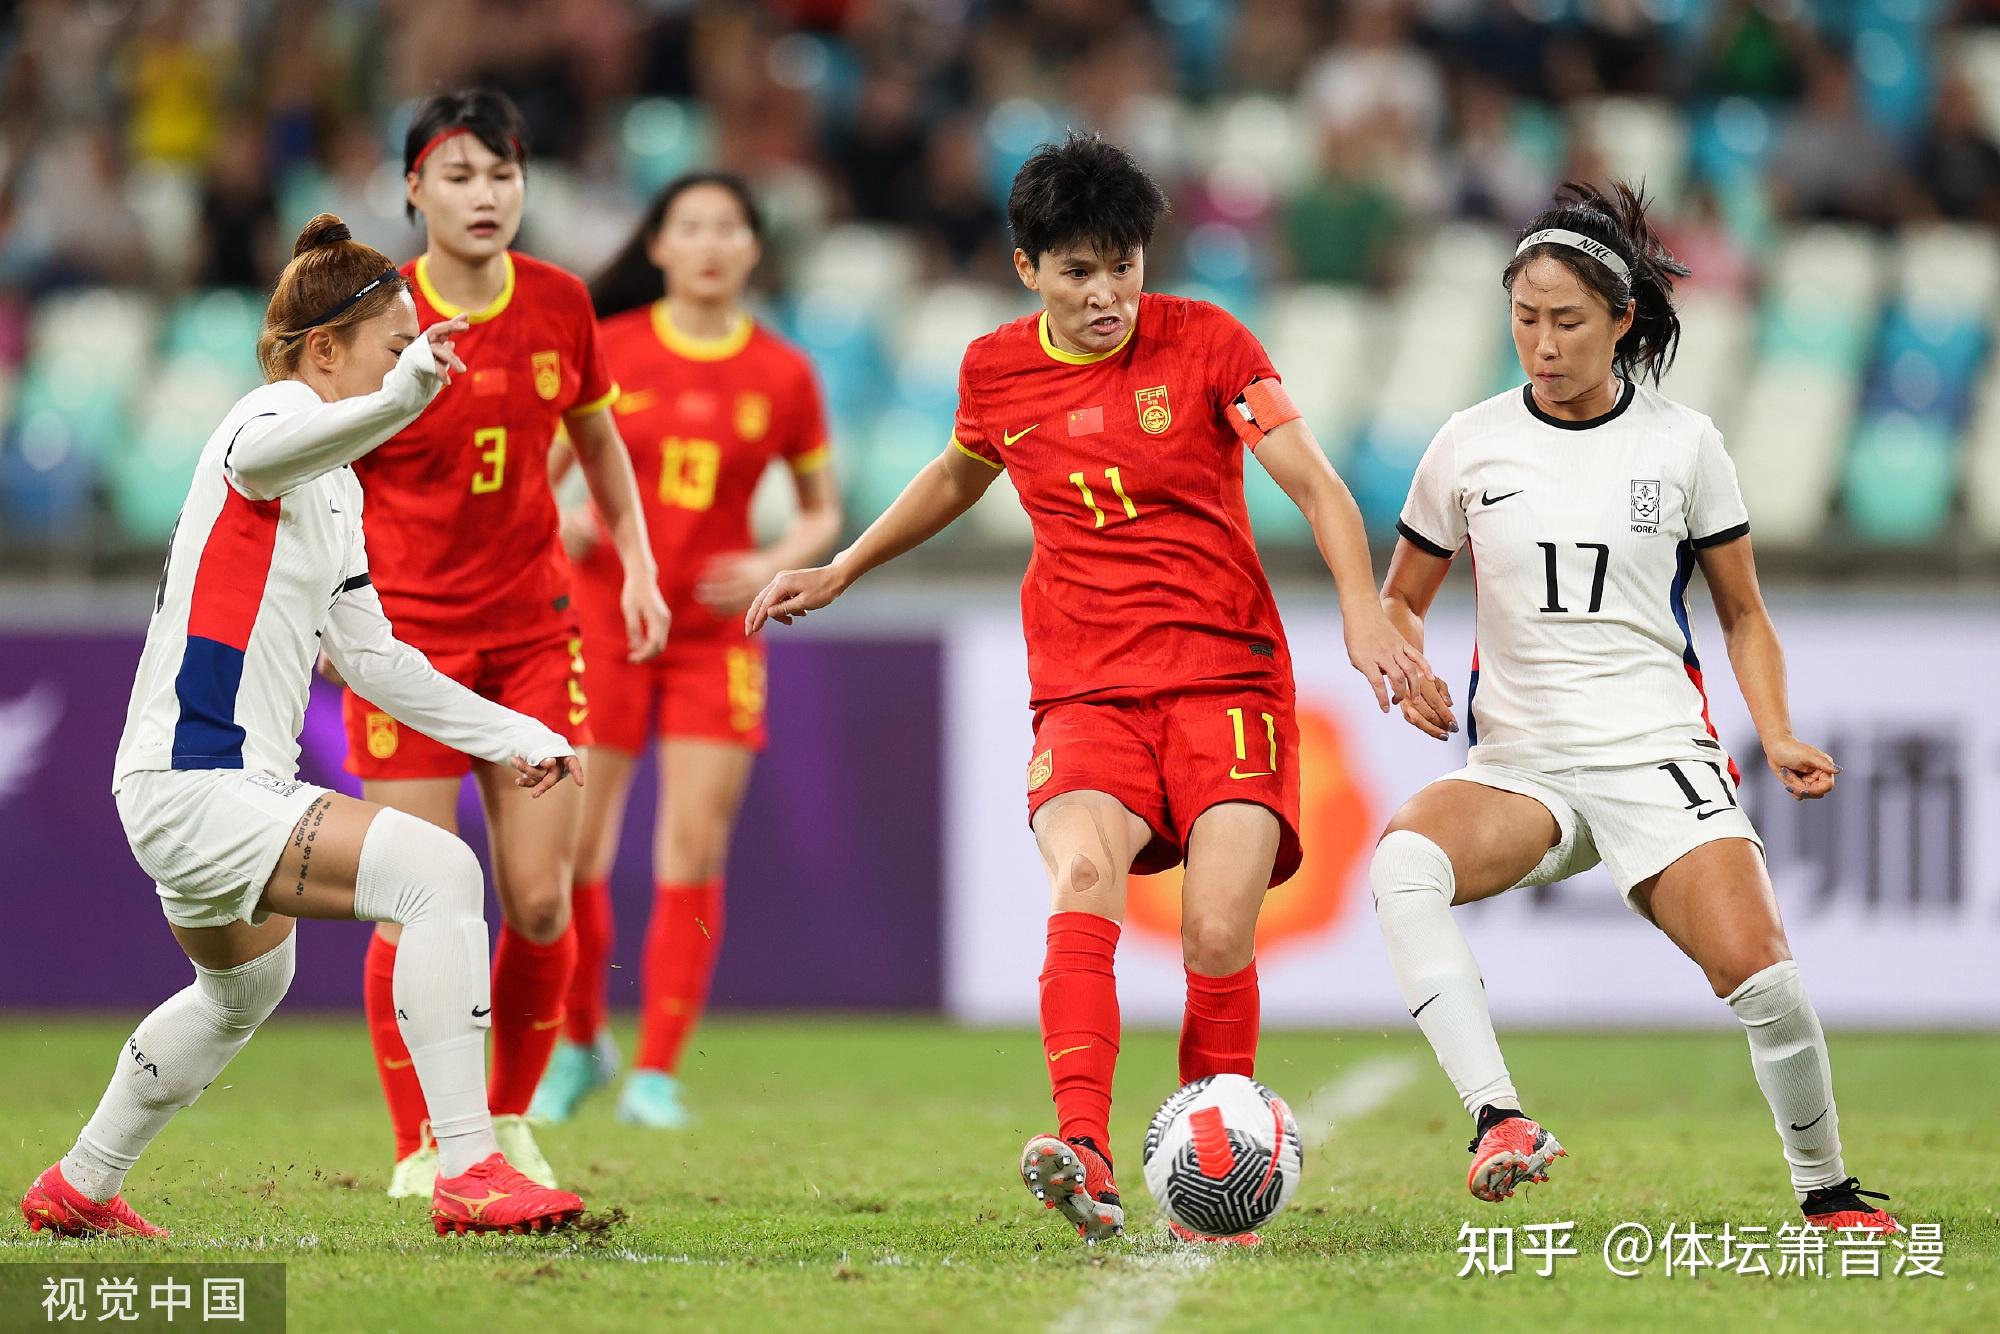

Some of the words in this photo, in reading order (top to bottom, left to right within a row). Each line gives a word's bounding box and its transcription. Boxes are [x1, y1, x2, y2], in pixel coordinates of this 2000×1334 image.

[1577, 239, 1612, 261] NIKE
[1139, 390, 1164, 401] CFA
[472, 427, 507, 494] 3
[660, 437, 720, 510] 13
[1069, 466, 1138, 528] 11
[1631, 525, 1658, 533] KOREA
[1536, 541, 1610, 613] 17
[1226, 707, 1277, 772] 11
[130, 1038, 158, 1077] REA
